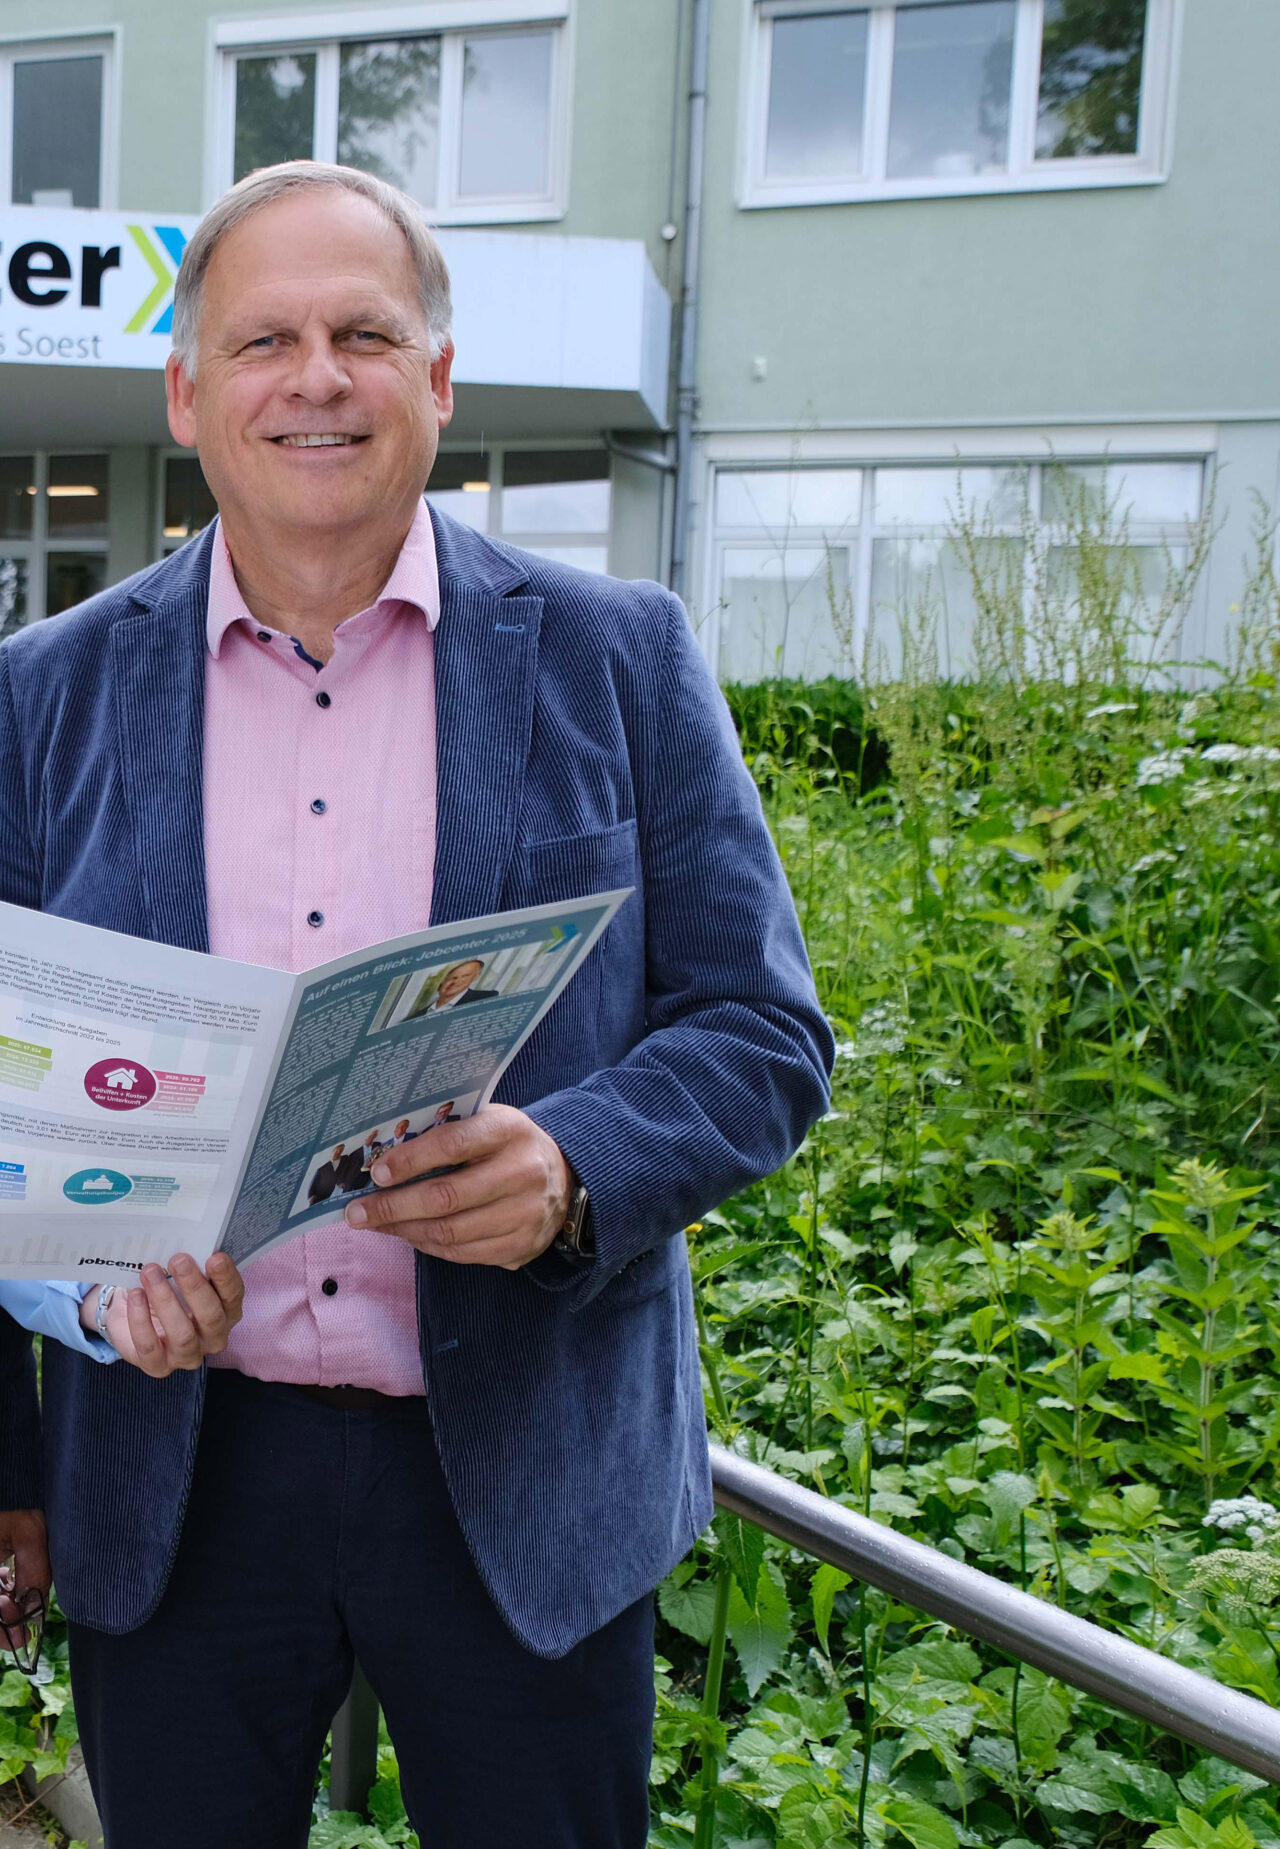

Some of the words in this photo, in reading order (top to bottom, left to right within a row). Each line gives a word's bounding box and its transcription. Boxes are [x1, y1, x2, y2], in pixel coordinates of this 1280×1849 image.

[16, 327, 102, 359] Soest
[304, 984, 331, 1004] Auf
[332, 970, 370, 991] einen
[372, 956, 413, 975] Blick:
[416, 938, 490, 962] Jobcenter
[491, 928, 528, 944] 2025
[31, 1012, 66, 1028] Entwicklung
[77, 1025, 108, 1036] Ausgaben
[92, 1086, 118, 1095] Beihilfen
[126, 1092, 147, 1100] Kosten
[107, 1096, 141, 1105] Unterkunft
[78, 1257, 144, 1270] jobcent
